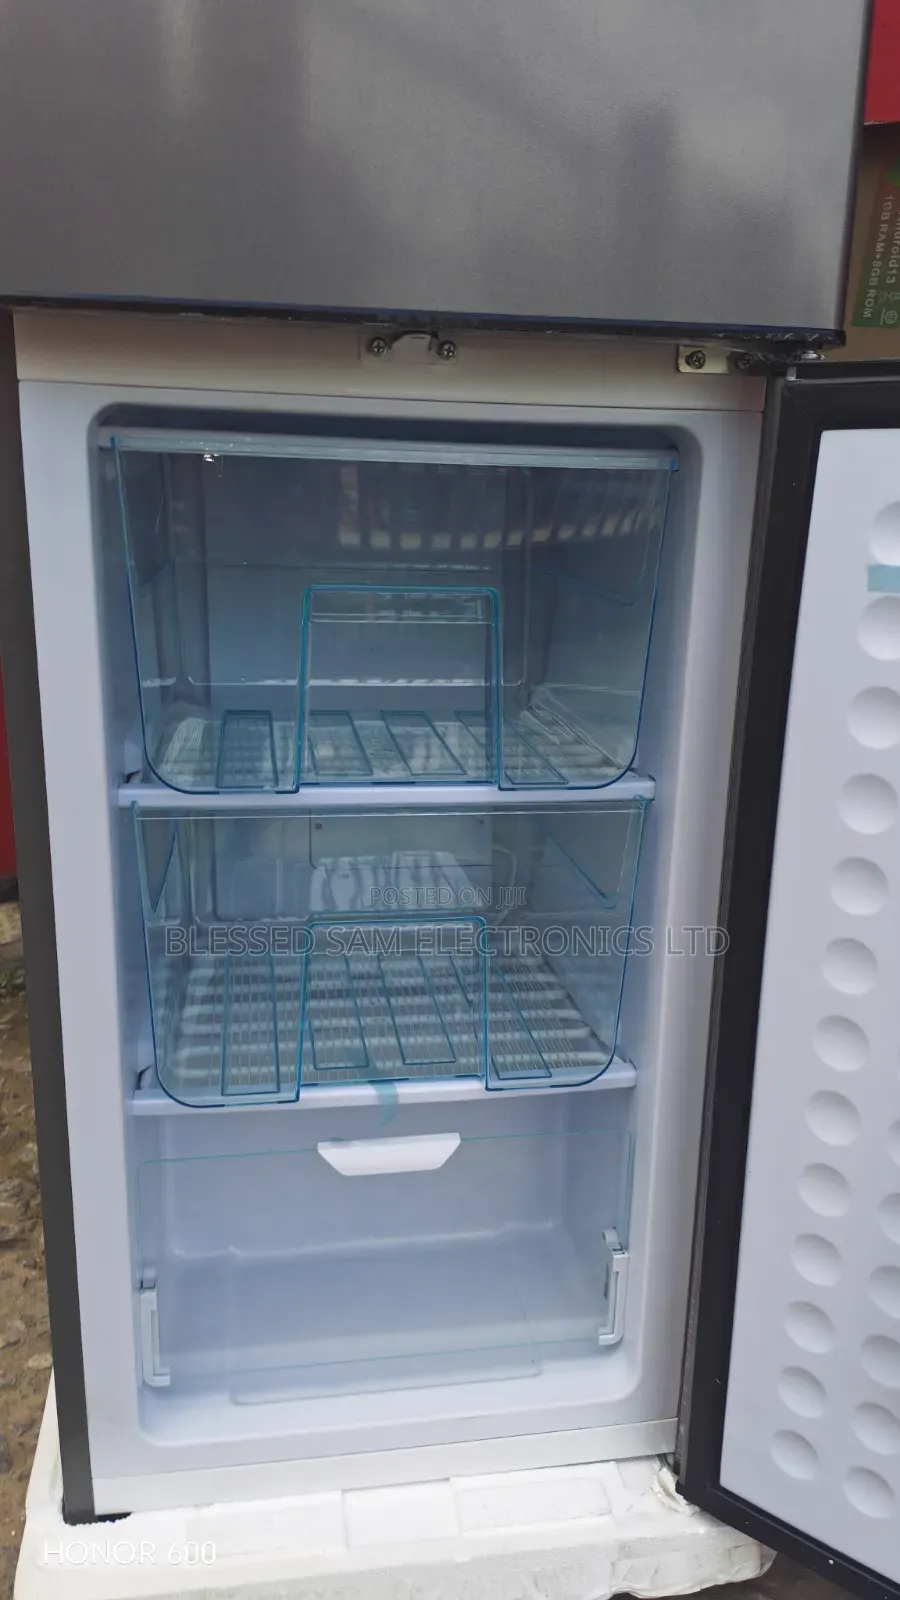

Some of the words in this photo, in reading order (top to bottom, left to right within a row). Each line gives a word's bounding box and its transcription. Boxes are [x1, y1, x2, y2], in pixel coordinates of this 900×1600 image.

[881, 196, 894, 221] 1GB
[869, 224, 888, 286] RAM+8GB
[862, 290, 877, 318] ROM
